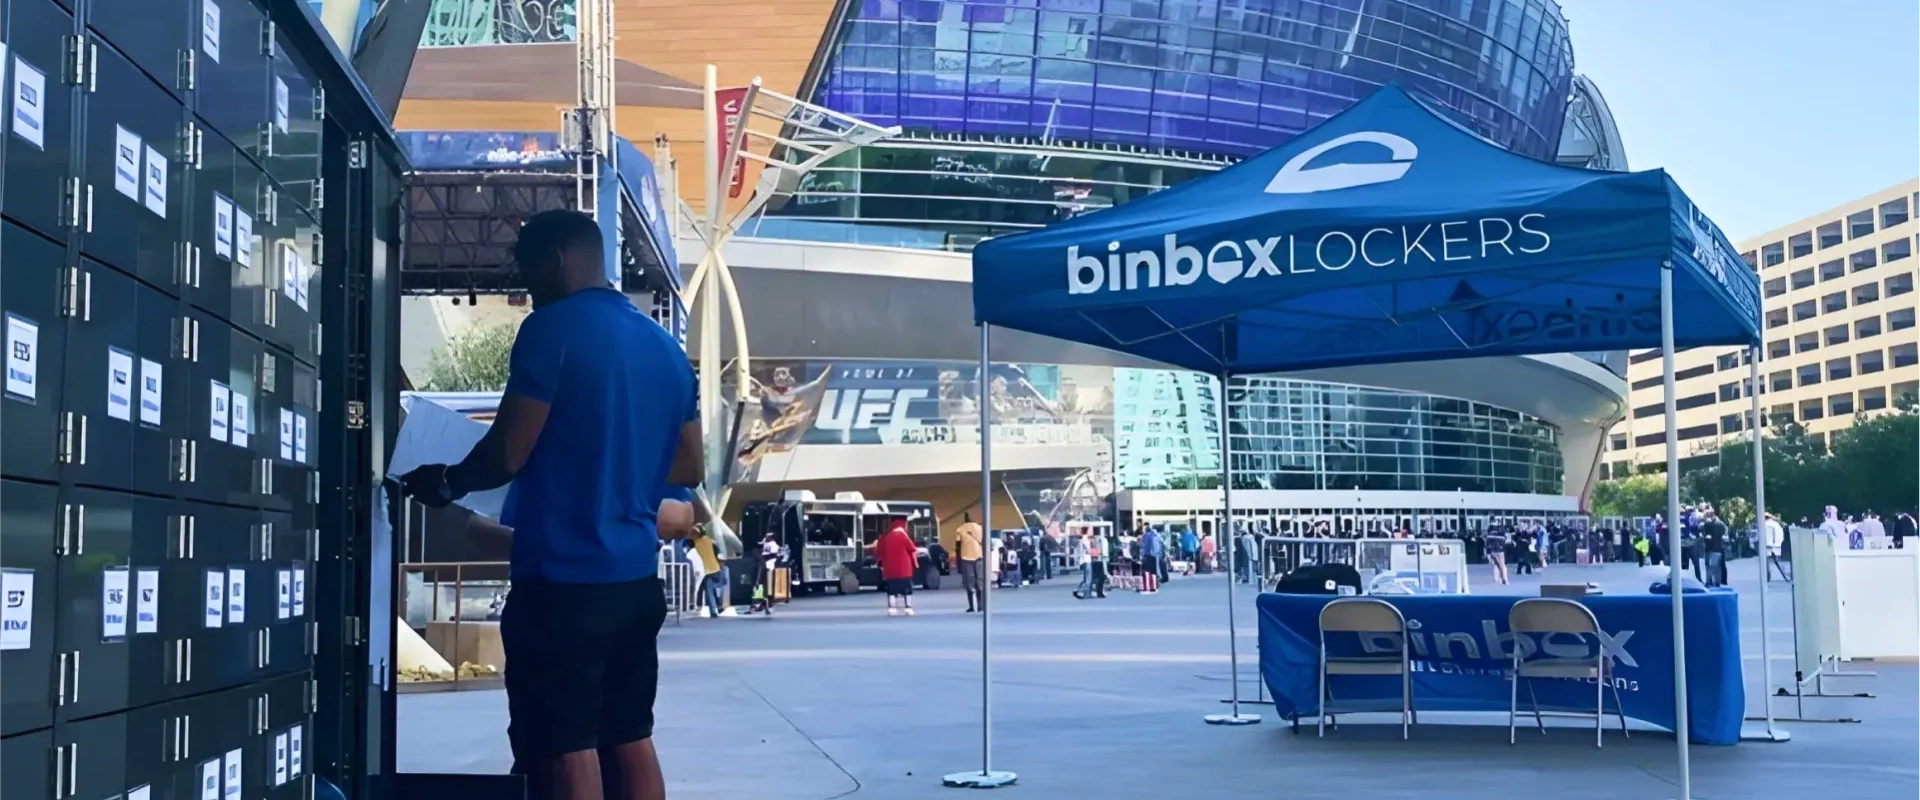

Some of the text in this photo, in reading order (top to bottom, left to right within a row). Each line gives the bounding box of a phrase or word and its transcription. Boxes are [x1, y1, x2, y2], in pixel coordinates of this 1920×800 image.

[1067, 213, 1550, 295] binbox LOCKERS
[814, 388, 929, 444] UFC
